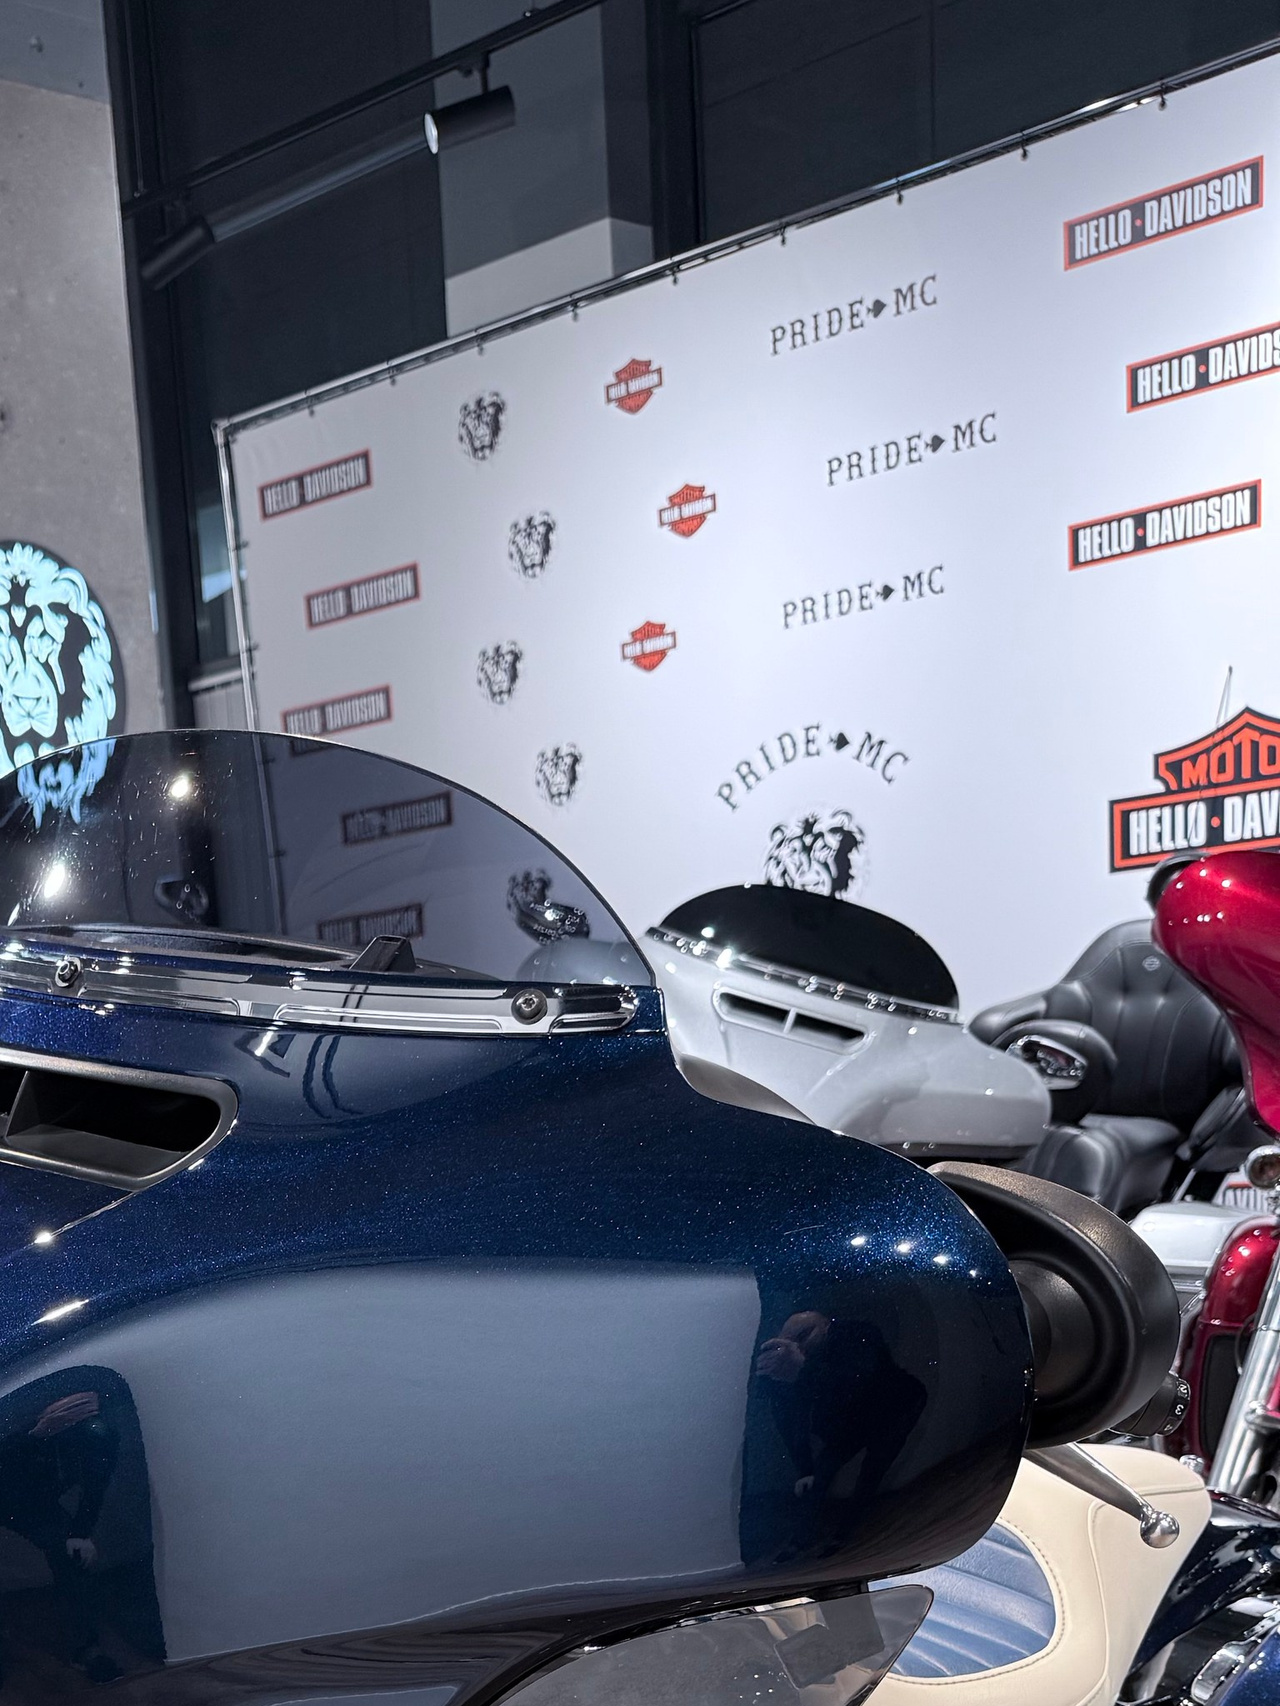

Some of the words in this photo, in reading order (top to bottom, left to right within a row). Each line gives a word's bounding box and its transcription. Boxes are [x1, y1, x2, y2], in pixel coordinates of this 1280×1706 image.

[1074, 208, 1132, 260] HELLO
[1144, 168, 1252, 238] DAVIDSON
[770, 297, 865, 356] PRIDE
[893, 273, 938, 317] MC
[1136, 353, 1196, 404] HELLO
[826, 431, 923, 487] PRIDE
[951, 411, 997, 453] MC
[1078, 517, 1135, 563] HELLO
[1146, 488, 1251, 548] DAVIDSON
[782, 580, 874, 630] PRIDE
[902, 563, 945, 602] MC
[715, 721, 821, 812] PRIDE
[852, 731, 911, 785] MC
[1129, 801, 1207, 856] HELLO
[1224, 789, 1280, 843] DAV
[1175, 1404, 1184, 1415] 3
